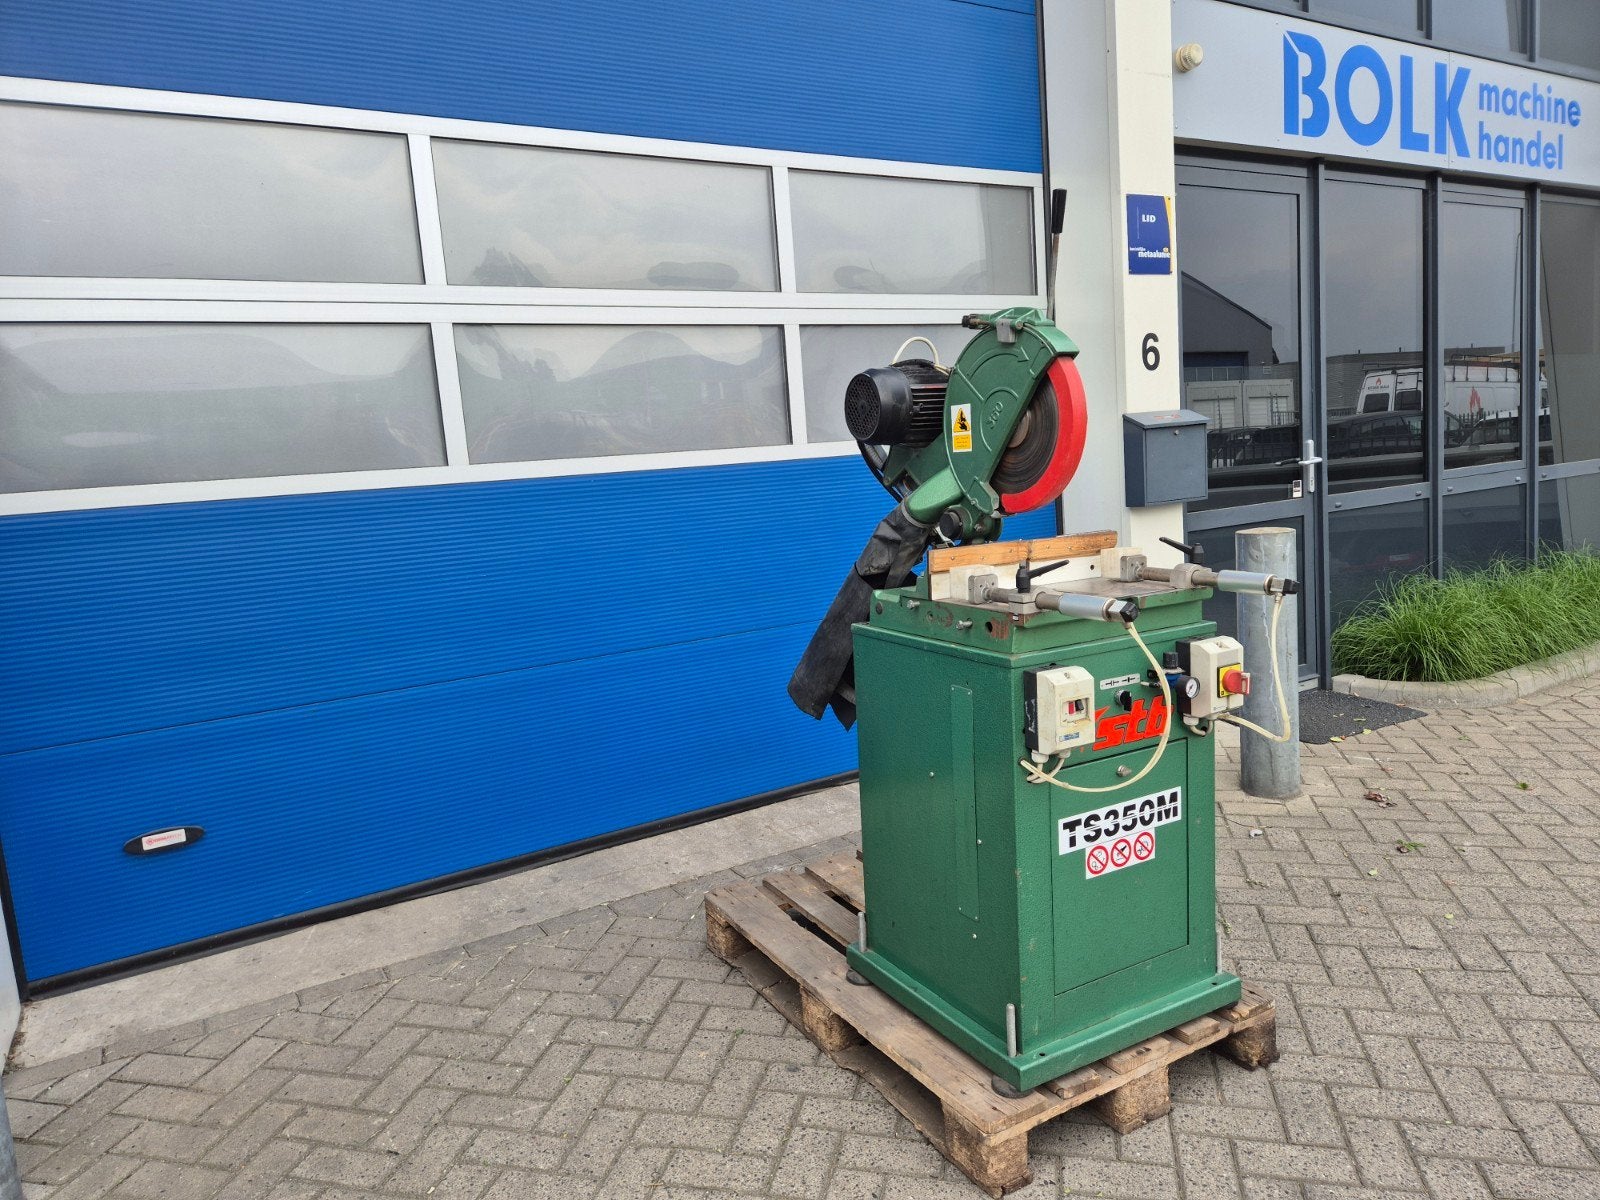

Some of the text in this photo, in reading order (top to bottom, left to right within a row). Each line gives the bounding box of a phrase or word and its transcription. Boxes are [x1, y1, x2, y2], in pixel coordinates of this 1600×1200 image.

[1283, 30, 1471, 159] BOLK
[1478, 82, 1581, 127] machine
[1478, 120, 1563, 170] handel
[1141, 214, 1156, 223] LID
[1142, 332, 1160, 371] 6
[1062, 791, 1178, 848] TS350M
